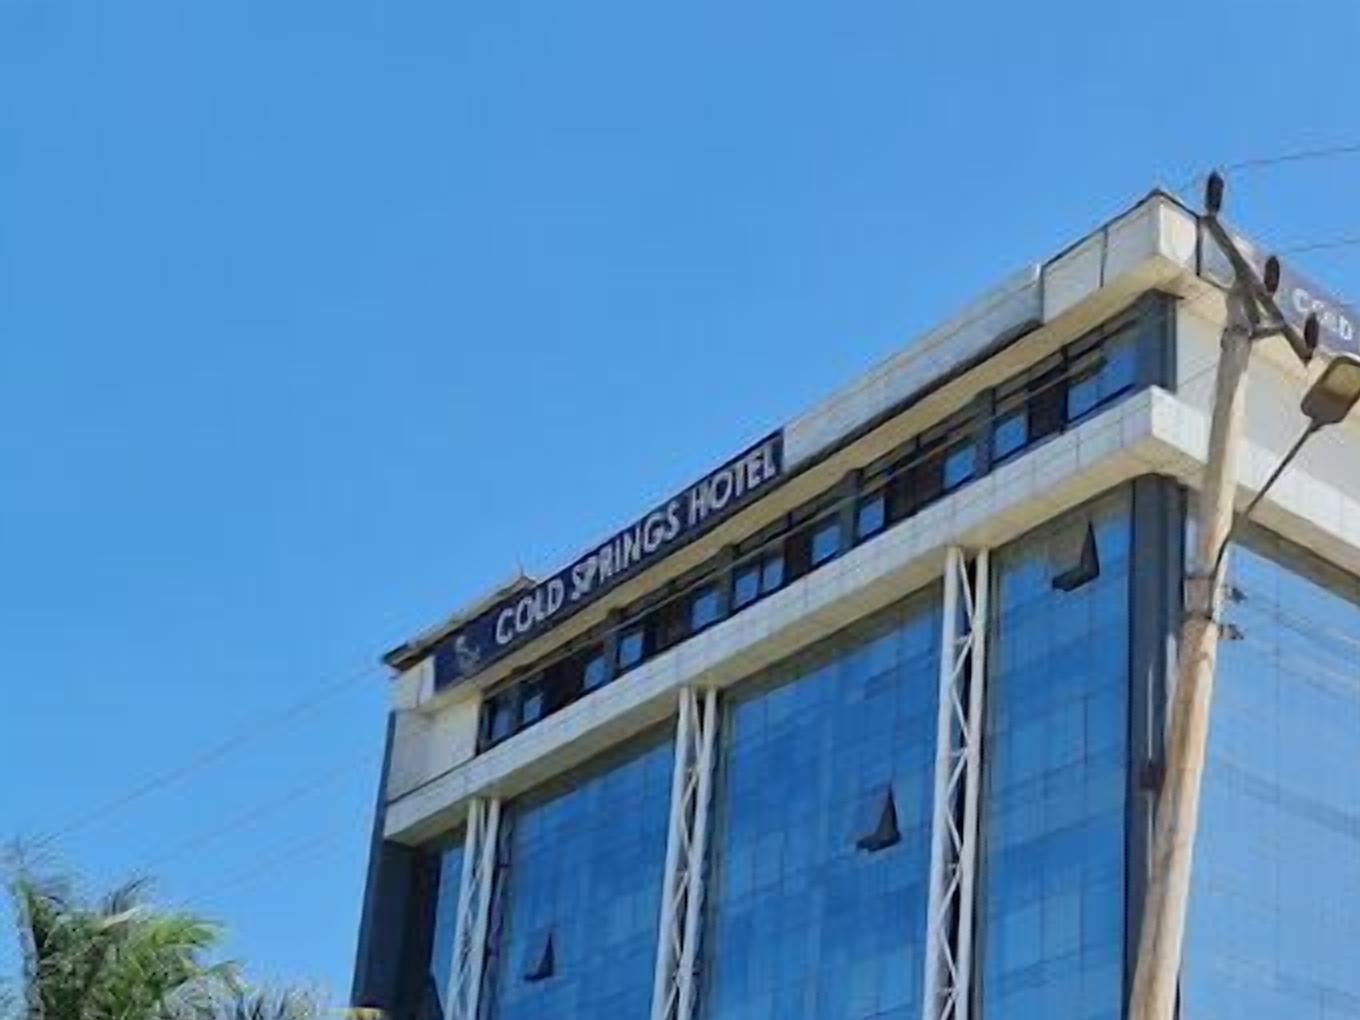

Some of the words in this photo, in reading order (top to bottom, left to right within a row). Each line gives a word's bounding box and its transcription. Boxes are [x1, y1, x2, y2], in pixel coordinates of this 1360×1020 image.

[495, 583, 564, 645] COLD
[571, 499, 680, 600] SPRINGS
[688, 443, 776, 527] HOTEL
